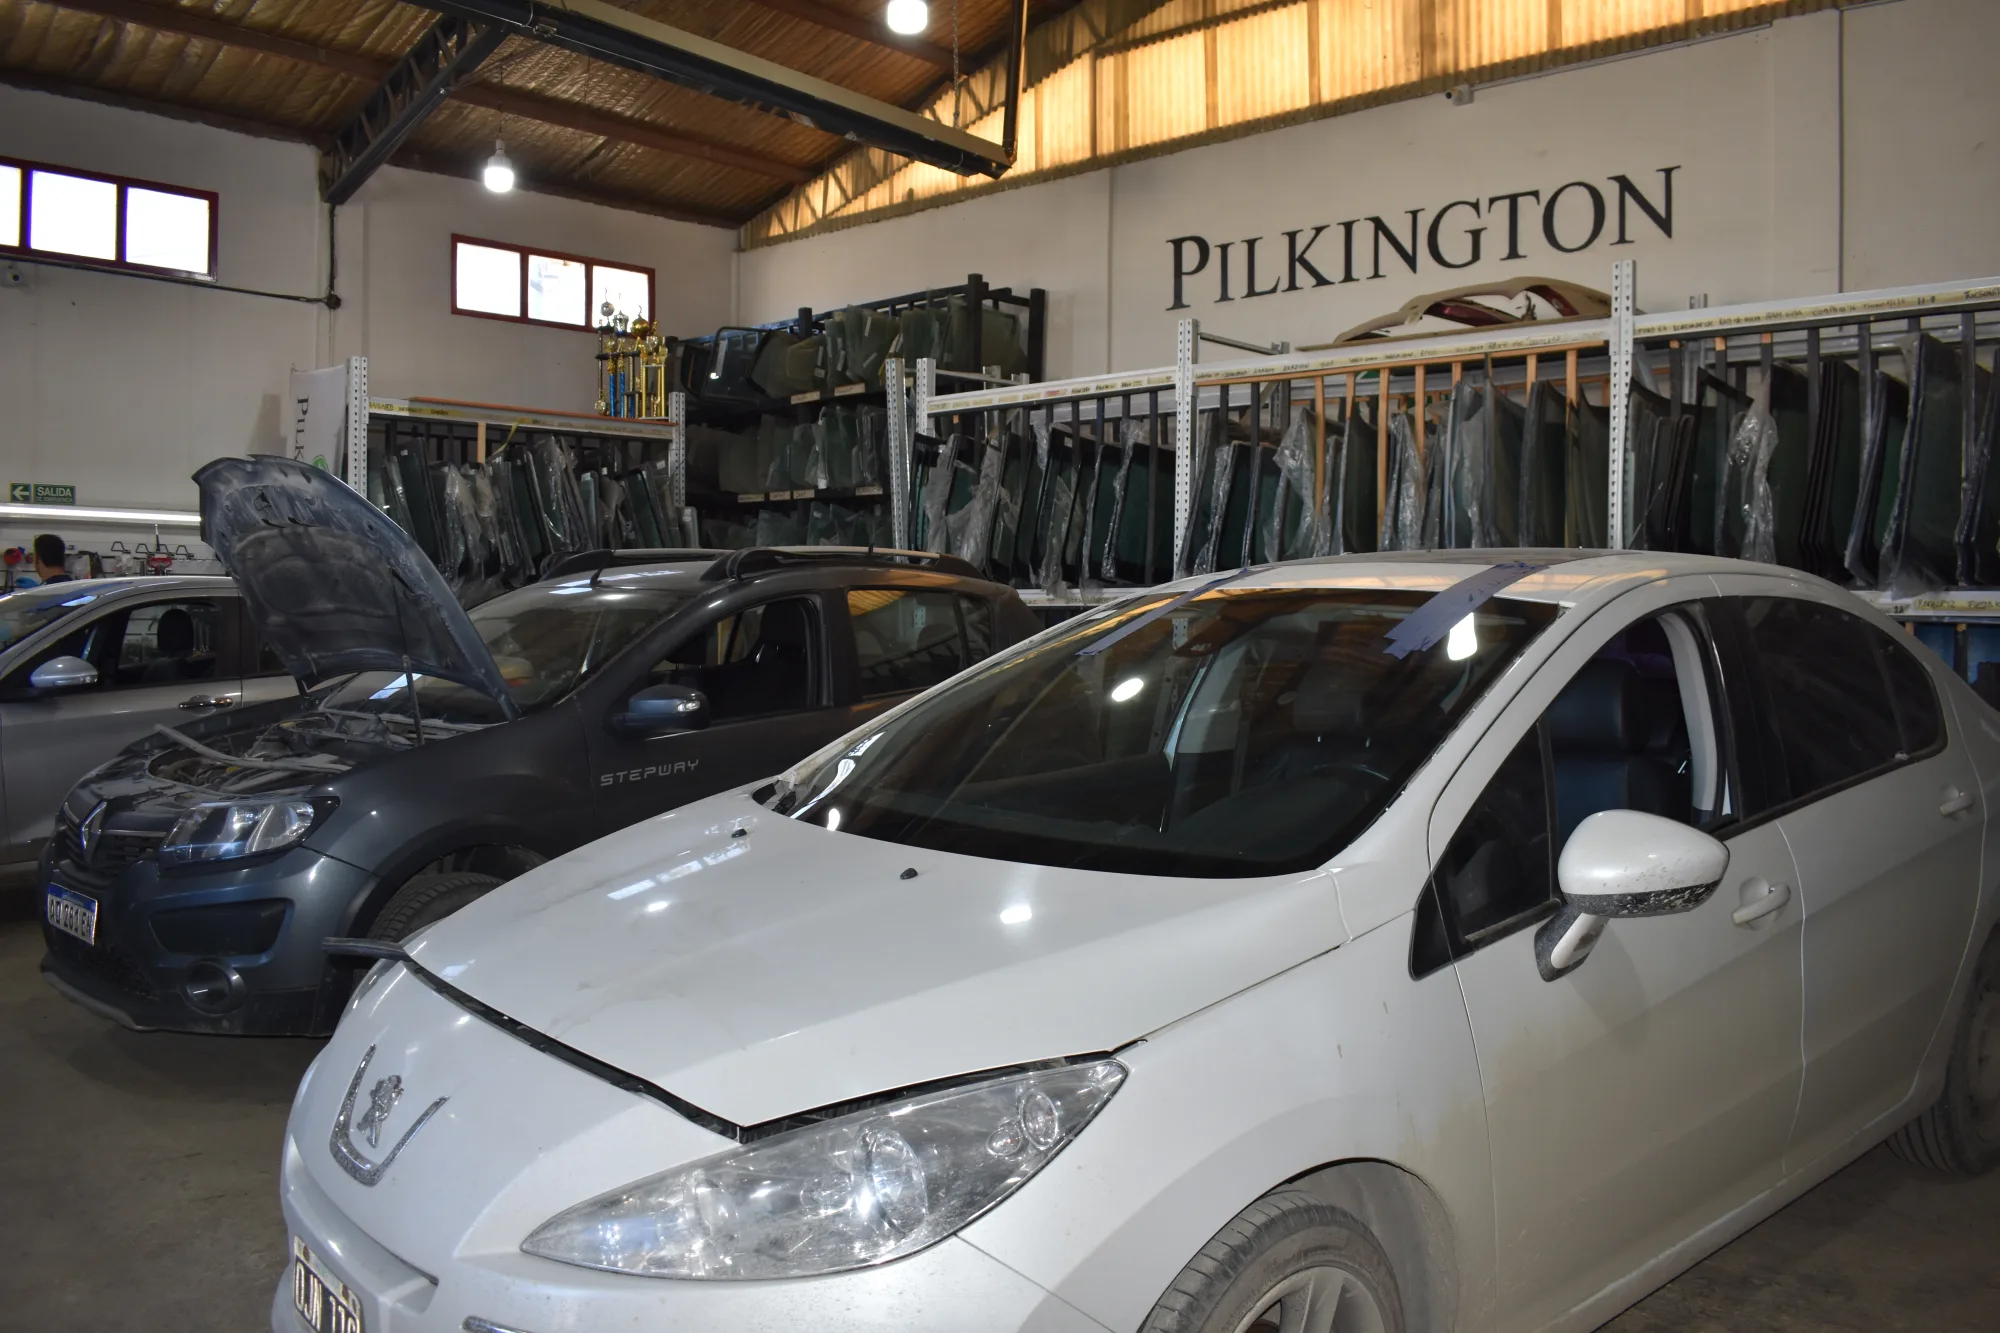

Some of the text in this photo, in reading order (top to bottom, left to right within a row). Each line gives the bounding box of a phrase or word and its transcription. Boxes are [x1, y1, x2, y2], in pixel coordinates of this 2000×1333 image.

[1166, 165, 1682, 311] PILKINGTON
[37, 486, 72, 497] SALIDA
[600, 757, 700, 787] STEPWAY
